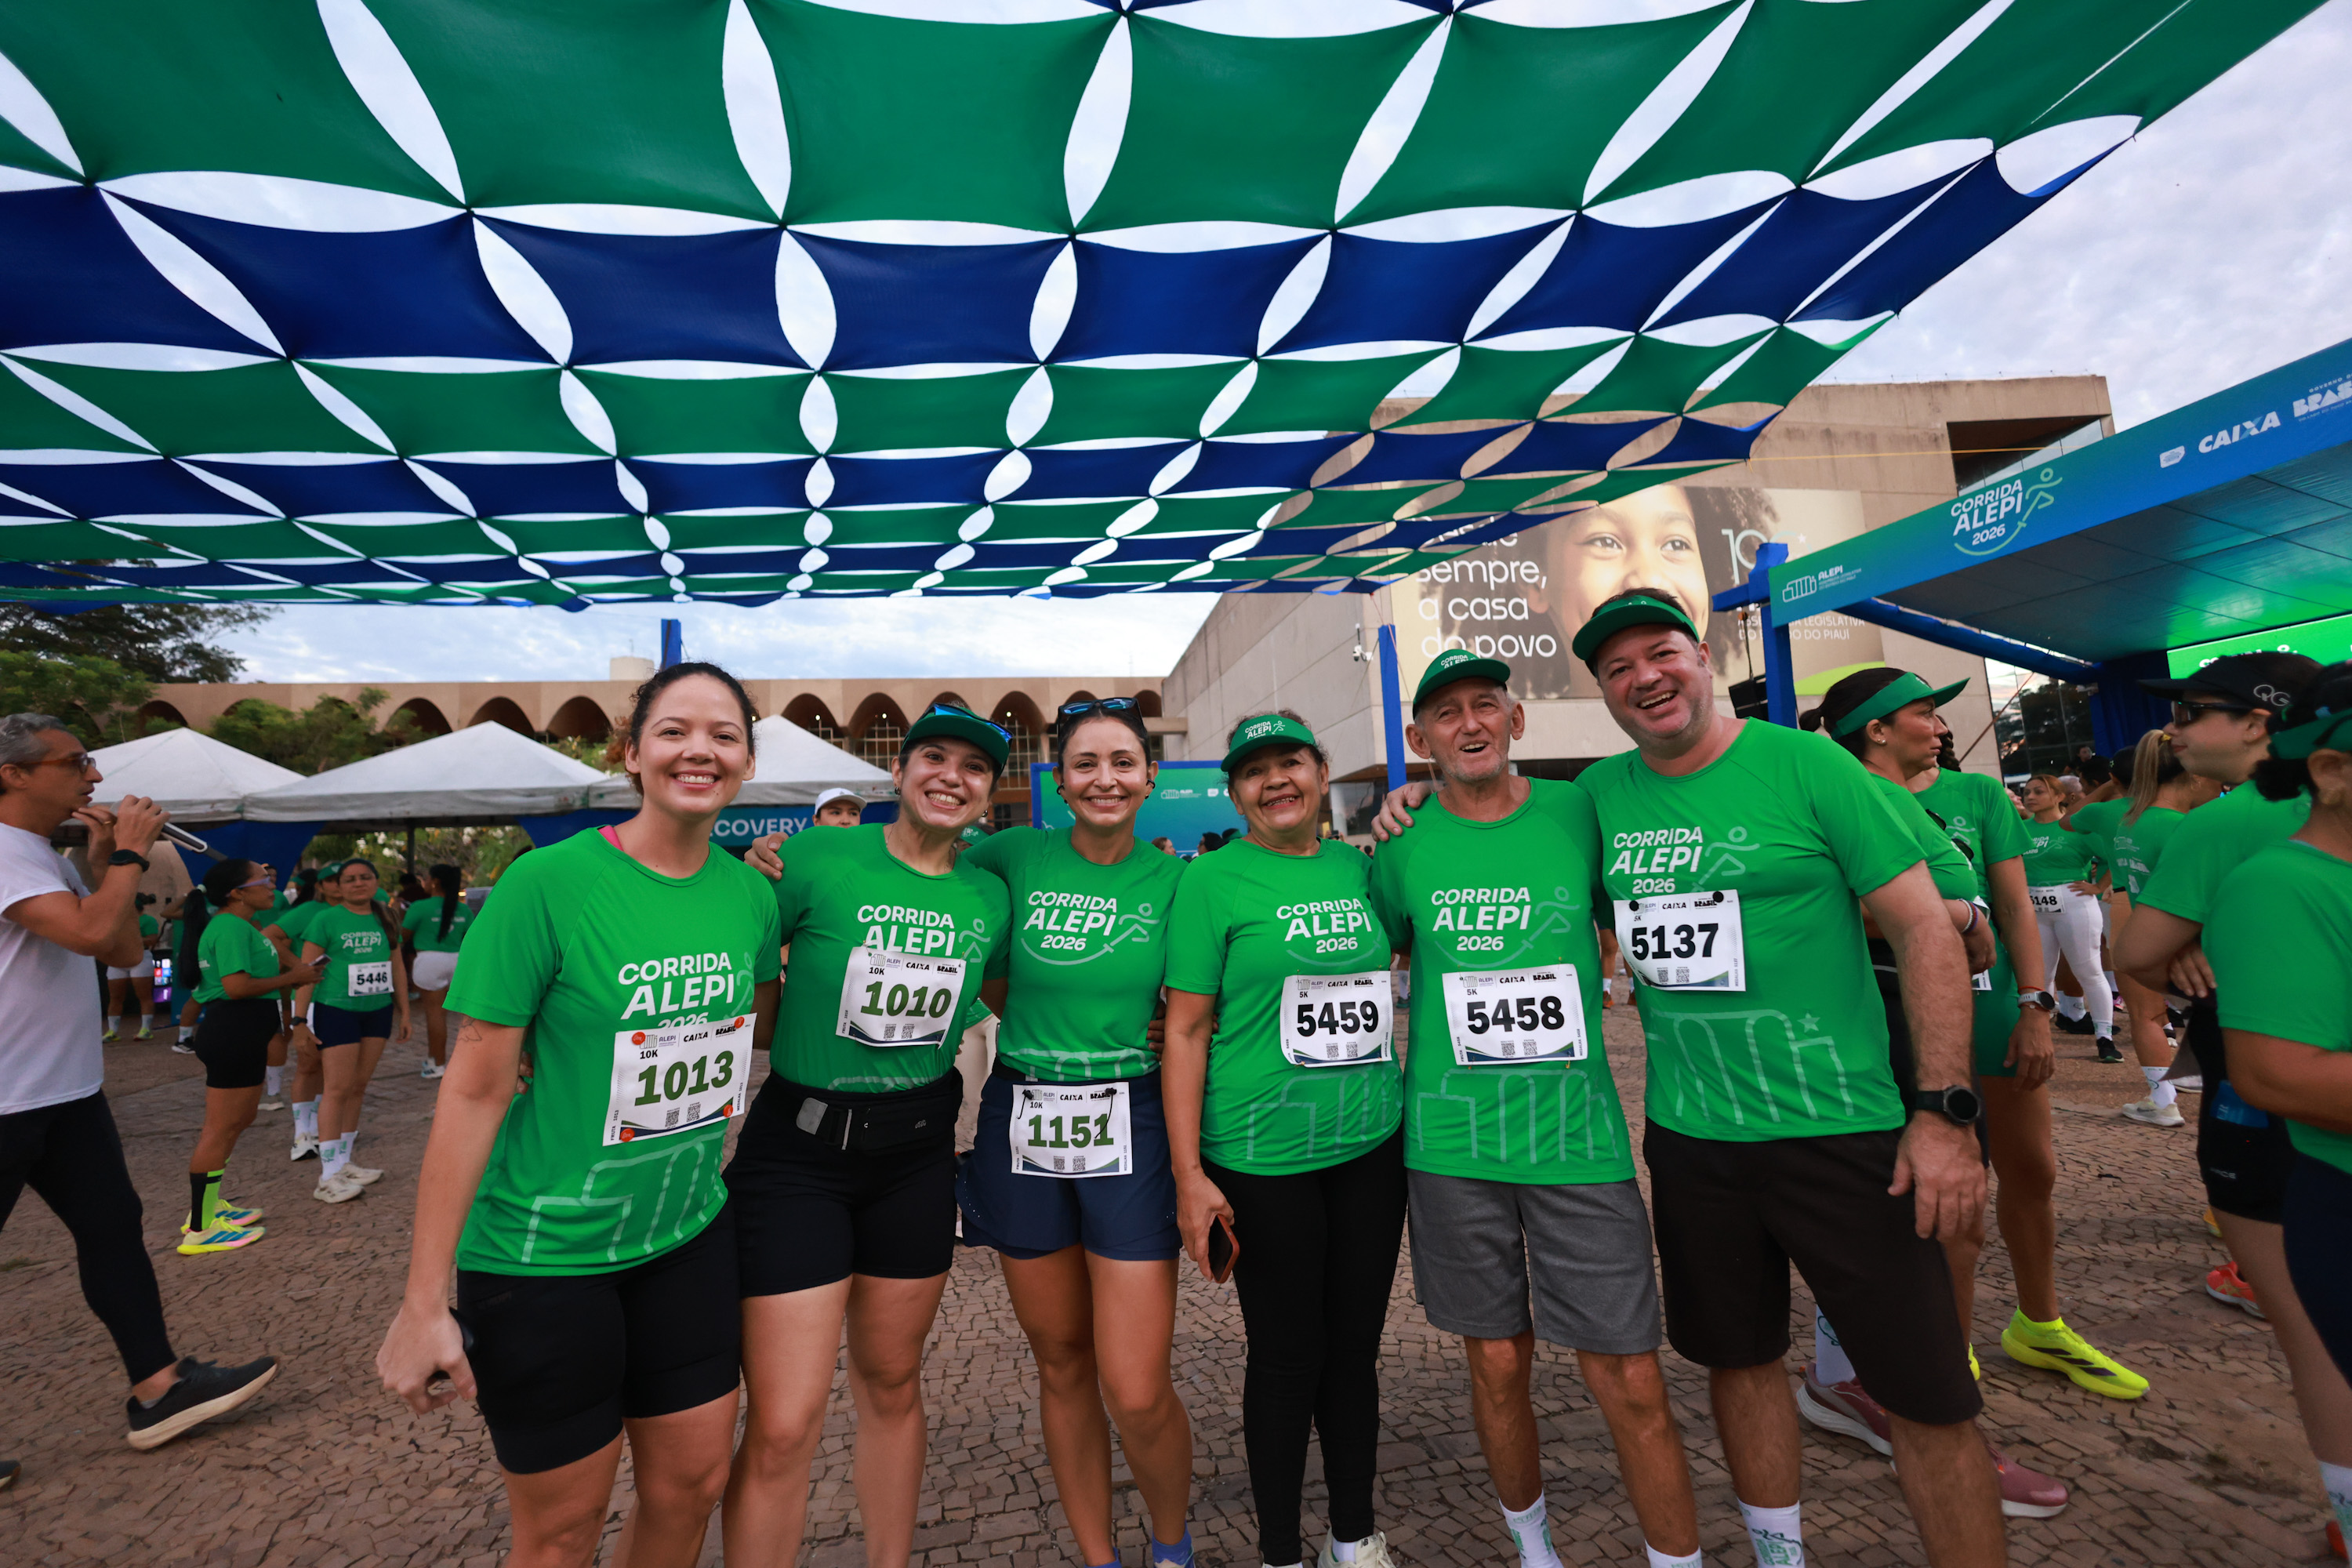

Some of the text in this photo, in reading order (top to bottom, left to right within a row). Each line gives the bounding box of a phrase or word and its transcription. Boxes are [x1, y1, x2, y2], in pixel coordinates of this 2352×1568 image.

[2198, 411, 2281, 453] CAIXA
[1951, 479, 2023, 517] CORRIDA
[1953, 492, 2023, 536] ALEPI
[1972, 523, 2005, 546] 2026
[1818, 564, 1843, 581] ALEPI
[1418, 597, 1529, 621] a casa
[1804, 615, 1865, 627] LEGISLATIVA
[1421, 627, 1557, 659] do povo
[1804, 630, 1821, 641] DO
[1441, 655, 1468, 666] CORRIDA
[1245, 720, 1271, 734] CORRIDA
[1247, 725, 1272, 739] ALEPI
[710, 818, 808, 837] COVERY
[1613, 826, 1703, 848] CORRIDA
[1608, 846, 1703, 875] ALEPI
[1432, 887, 1530, 906] CORRIDA
[1632, 878, 1675, 894] 2026
[1028, 891, 1117, 913] CORRIDA
[1276, 898, 1363, 920] CORRIDA
[858, 905, 954, 929] CORRIDA
[1023, 908, 1116, 936] ALEPI
[1284, 912, 1372, 942] ALEPI
[1432, 905, 1531, 931] ALEPI
[341, 931, 381, 940] CORRIDA
[343, 936, 381, 949] ALEPI
[866, 925, 956, 956] ALEPI
[1040, 935, 1087, 951] 2026
[1316, 937, 1358, 953] 2026
[1457, 936, 1504, 951] 2026
[1632, 923, 1719, 960] 5137
[619, 953, 732, 985] CORRIDA
[869, 967, 884, 975] 10K
[906, 962, 930, 971] CAIXA
[357, 971, 388, 985] 5446
[620, 974, 734, 1020] ALEPI
[860, 981, 952, 1018] 1010
[1297, 1000, 1378, 1037] 5459
[1467, 996, 1565, 1035] 5458
[684, 1032, 709, 1043] CAIXA
[640, 1050, 658, 1059] 10K
[634, 1051, 734, 1106] 1013
[1028, 1113, 1114, 1149] 1151
